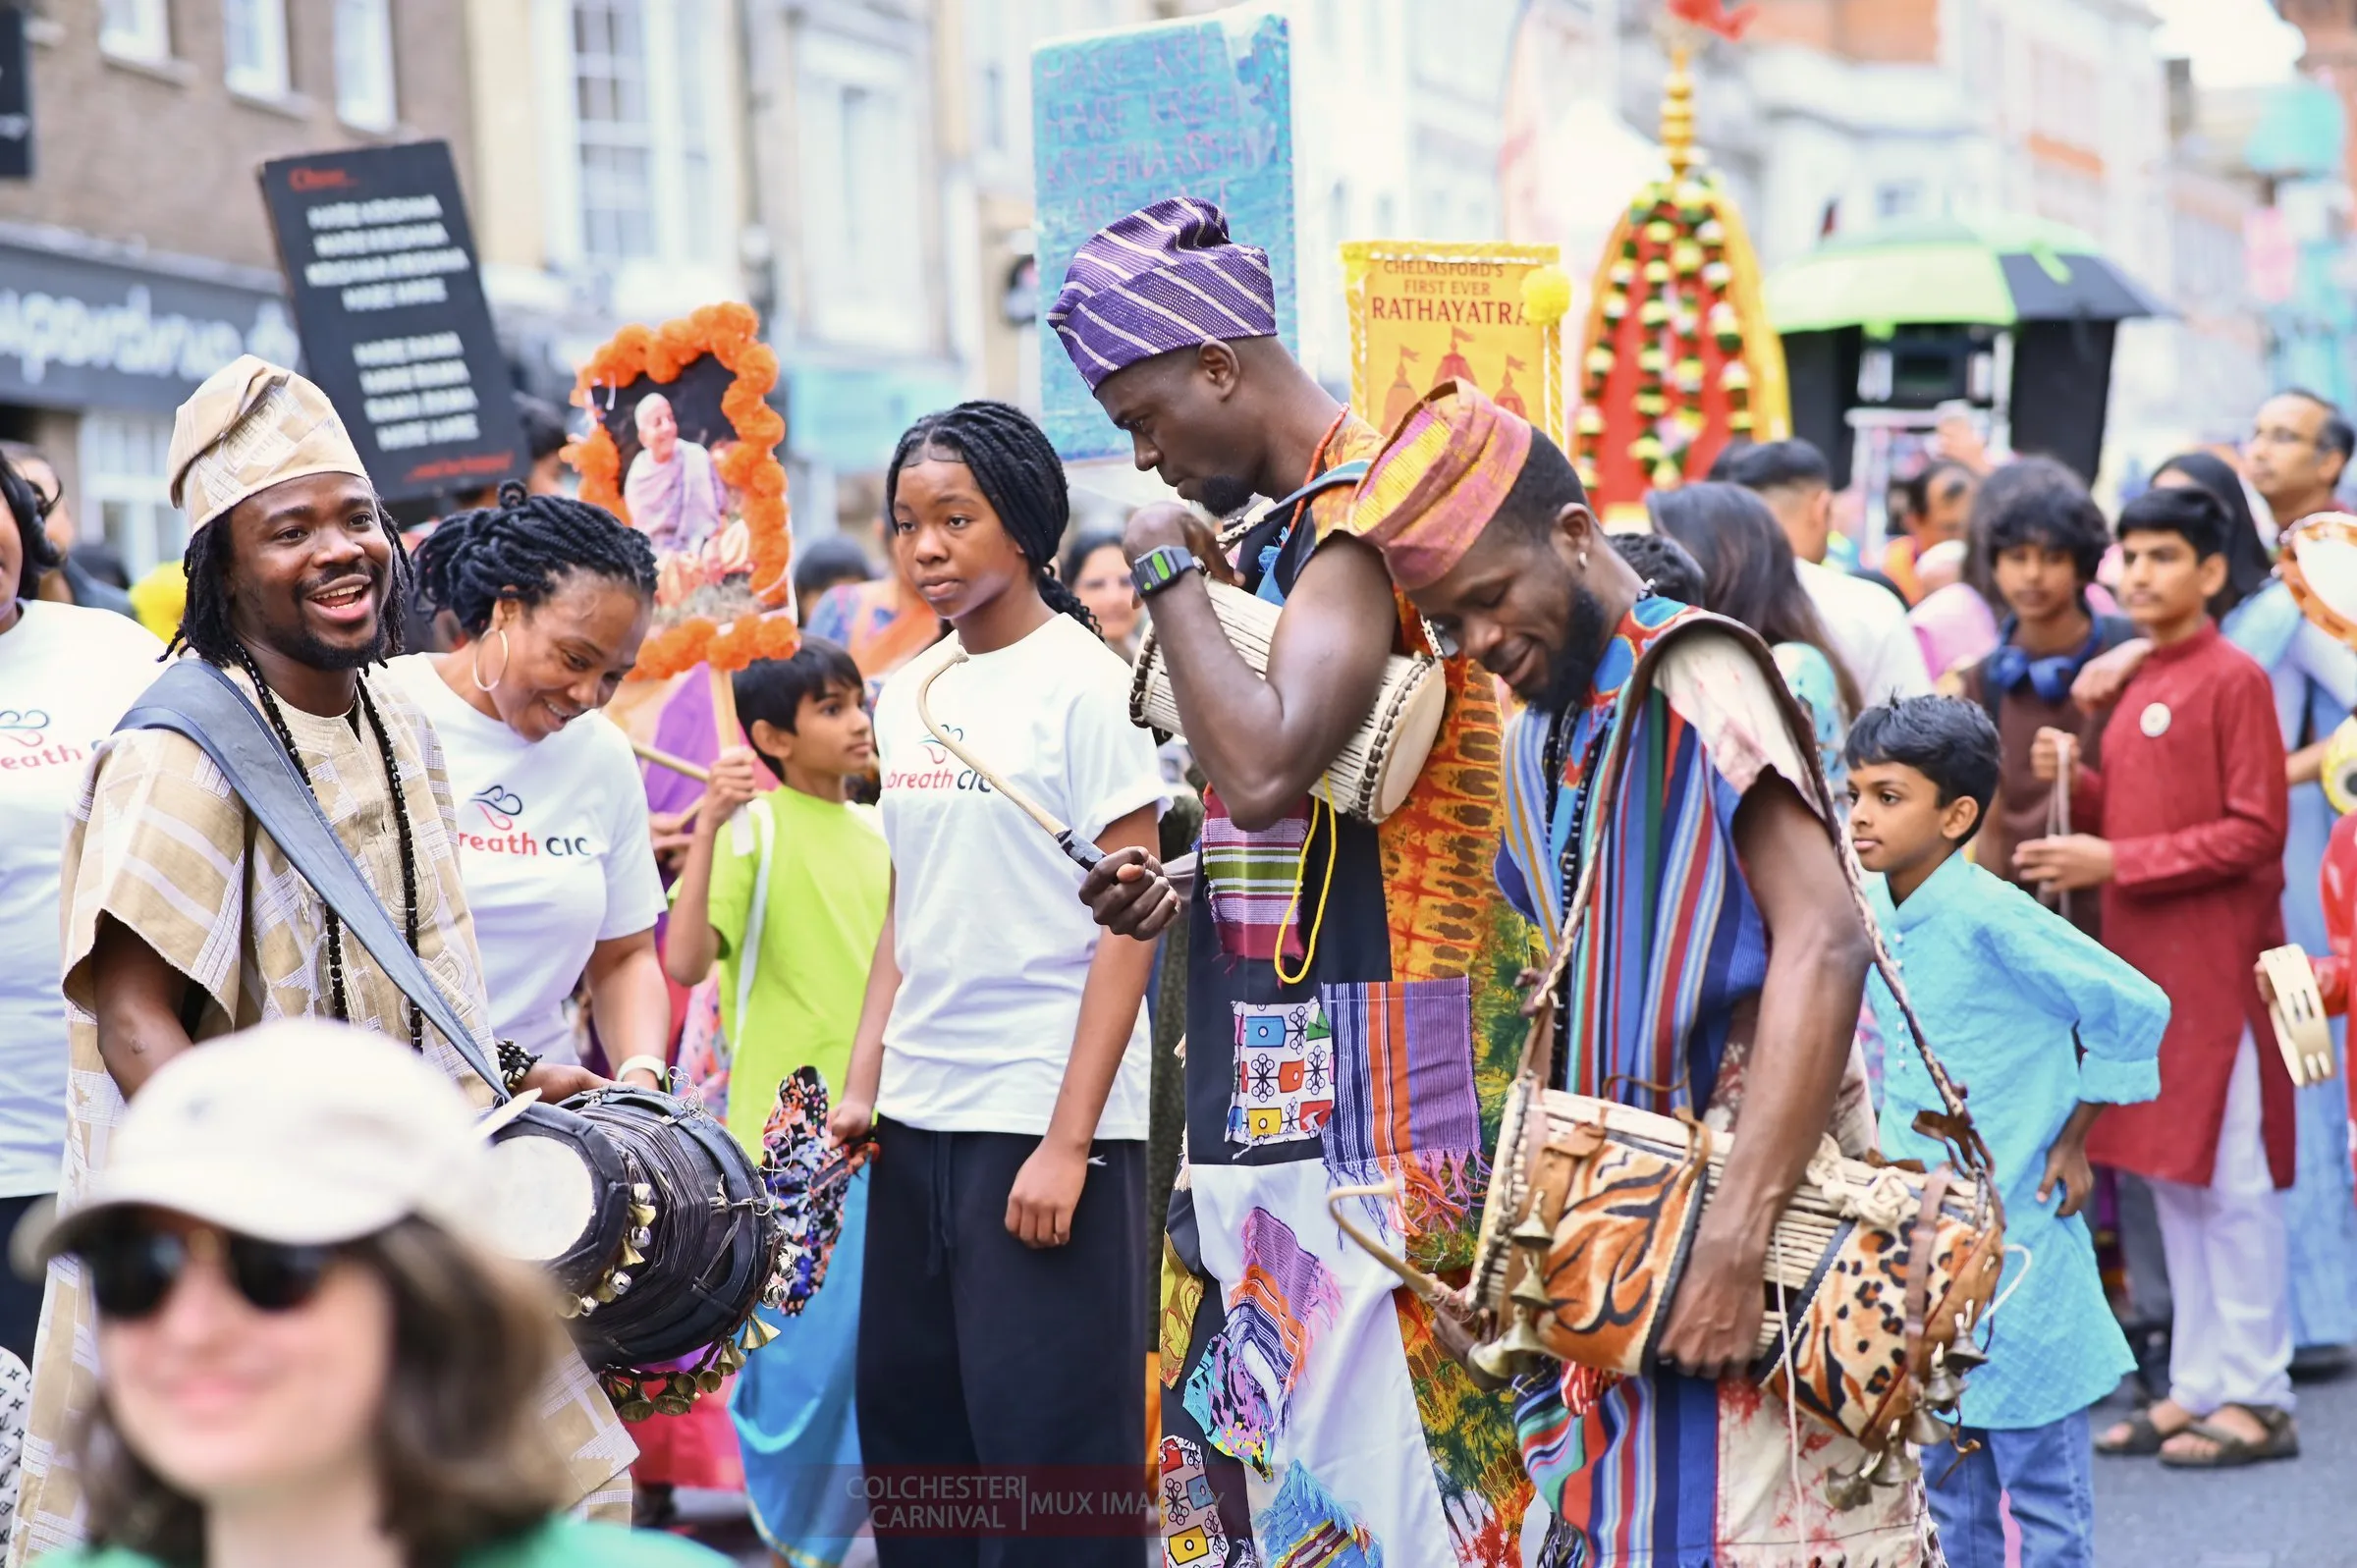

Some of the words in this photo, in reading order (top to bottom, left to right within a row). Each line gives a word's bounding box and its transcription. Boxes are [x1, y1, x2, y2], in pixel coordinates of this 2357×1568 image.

[1383, 260, 1505, 277] CHELMSFORD'S
[1404, 279, 1446, 295] FIRST
[1452, 281, 1491, 296] EVER
[0, 744, 82, 770] eath
[458, 832, 538, 856] reath
[545, 837, 591, 856] CIC
